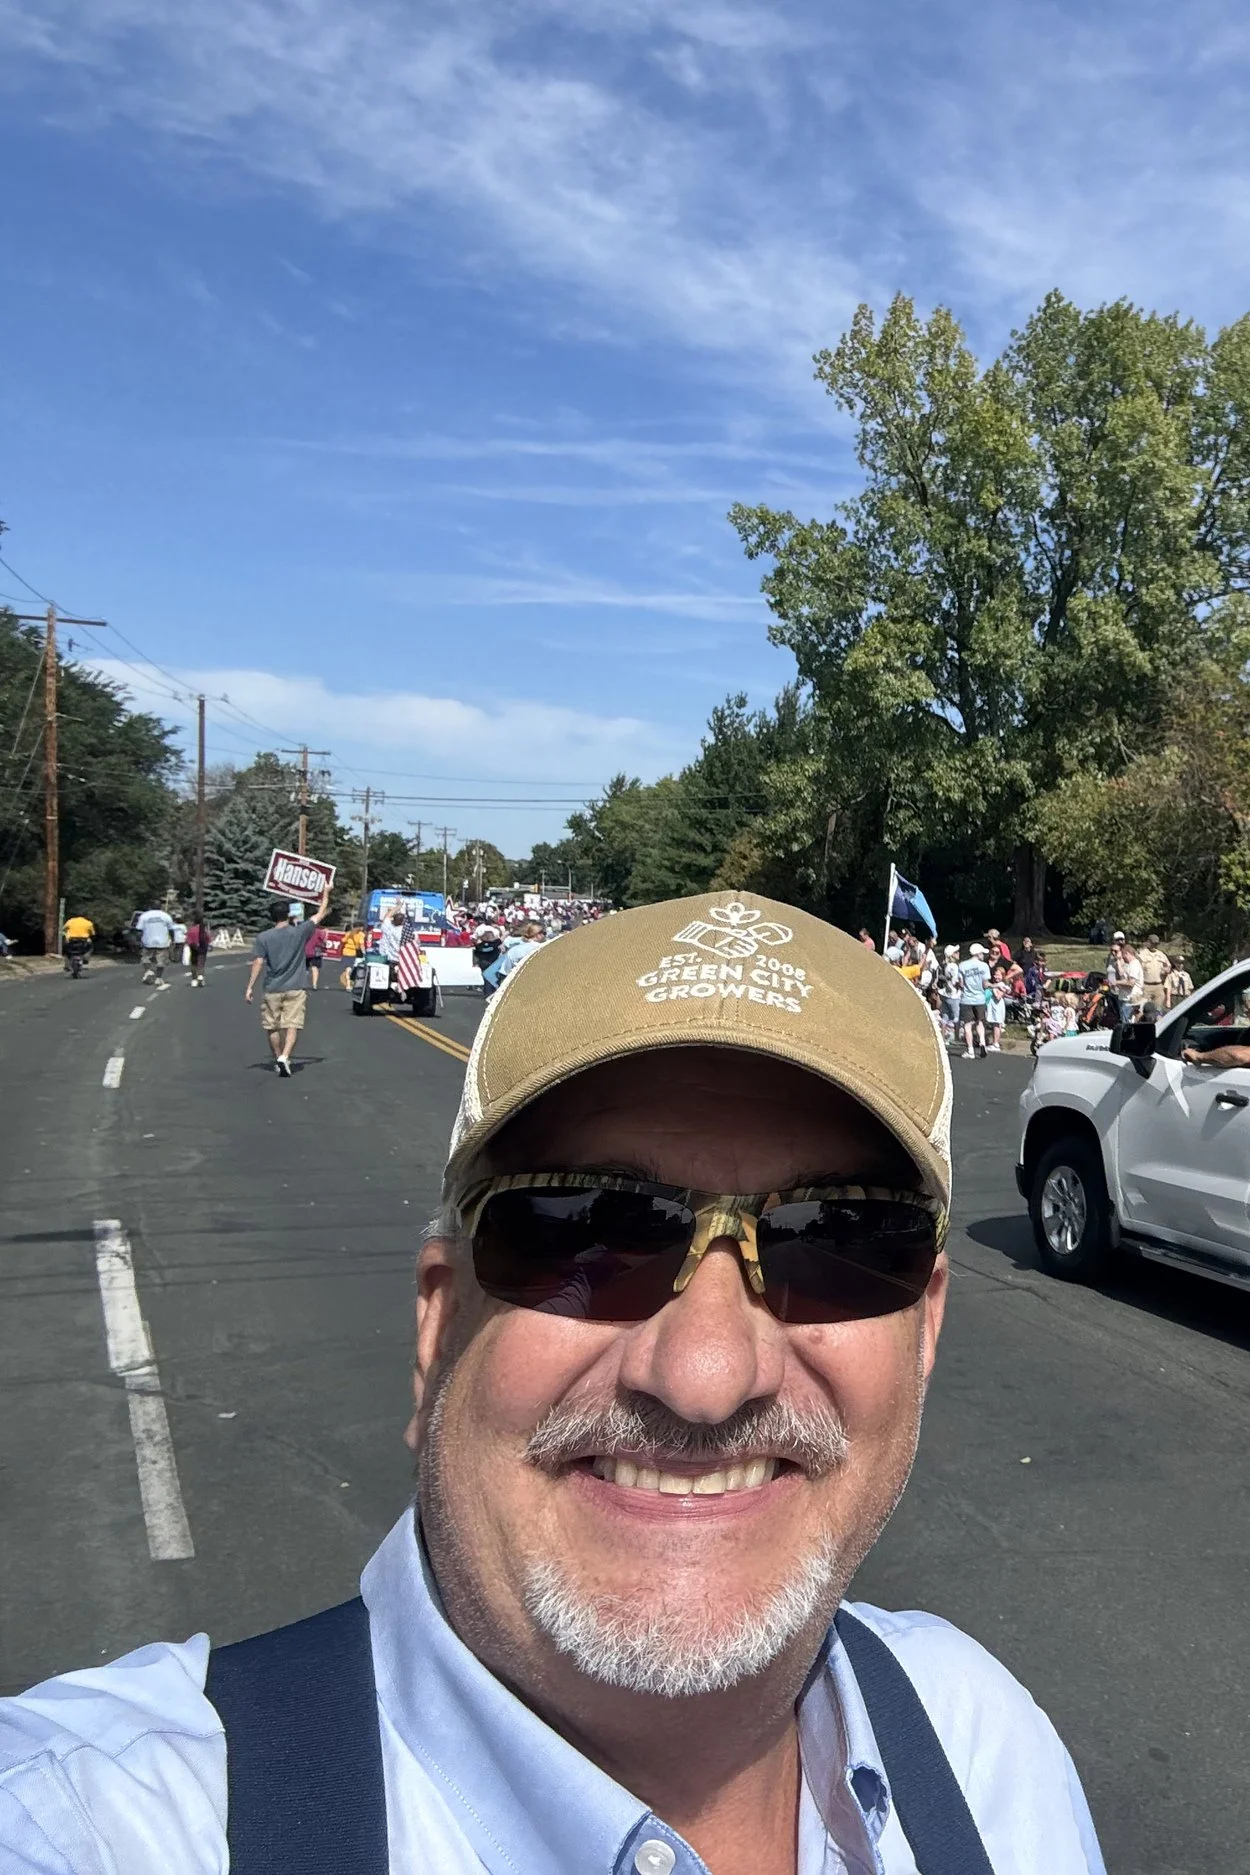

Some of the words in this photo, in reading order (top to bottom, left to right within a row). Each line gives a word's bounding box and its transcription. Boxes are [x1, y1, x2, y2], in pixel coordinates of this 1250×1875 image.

[274, 857, 326, 892] Hansen
[636, 964, 744, 988] GREEN
[750, 969, 814, 998] CITY
[659, 952, 702, 968] EST.
[756, 955, 807, 981] 2008
[645, 982, 802, 1013] GROWERS
